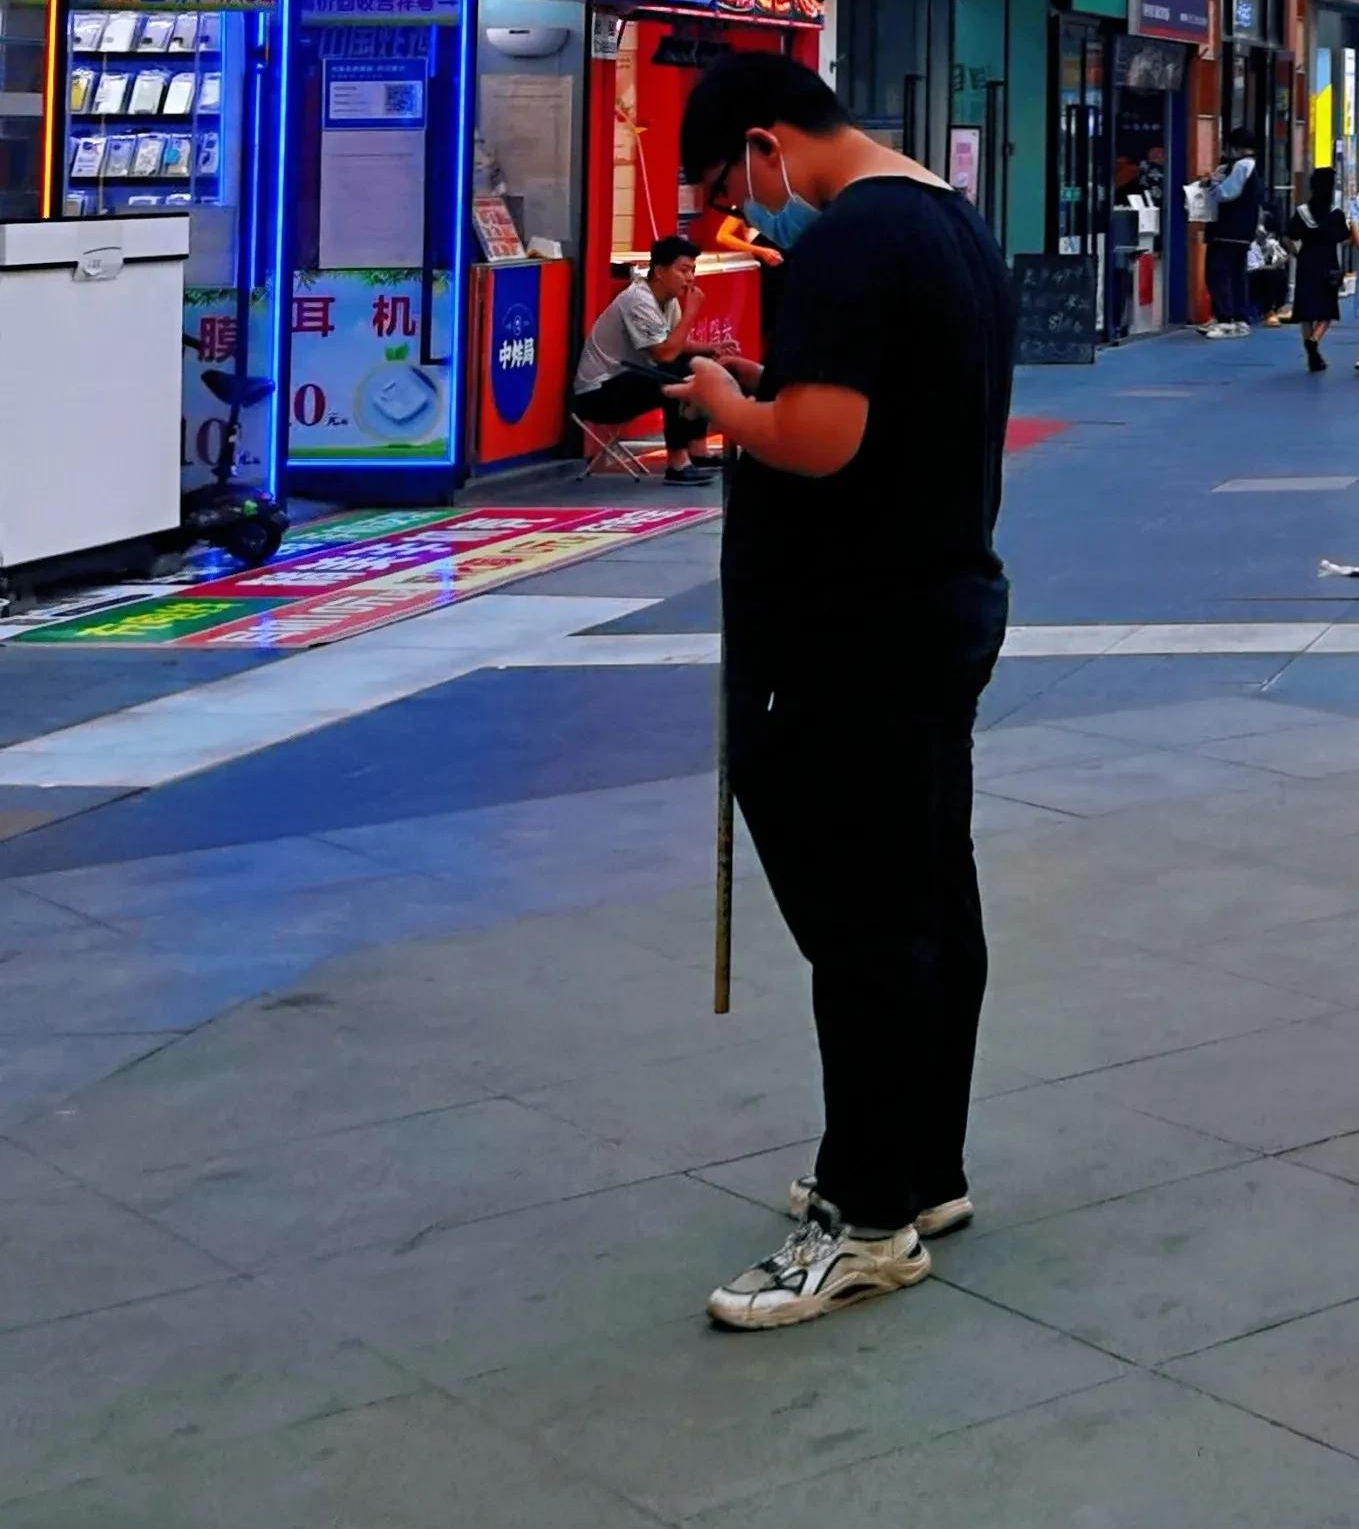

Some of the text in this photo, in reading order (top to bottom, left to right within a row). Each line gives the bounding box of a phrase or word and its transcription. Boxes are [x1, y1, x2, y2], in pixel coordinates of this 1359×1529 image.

[292, 295, 417, 338] 耳机
[499, 337, 535, 371] 中炸局
[290, 382, 326, 428] 0
